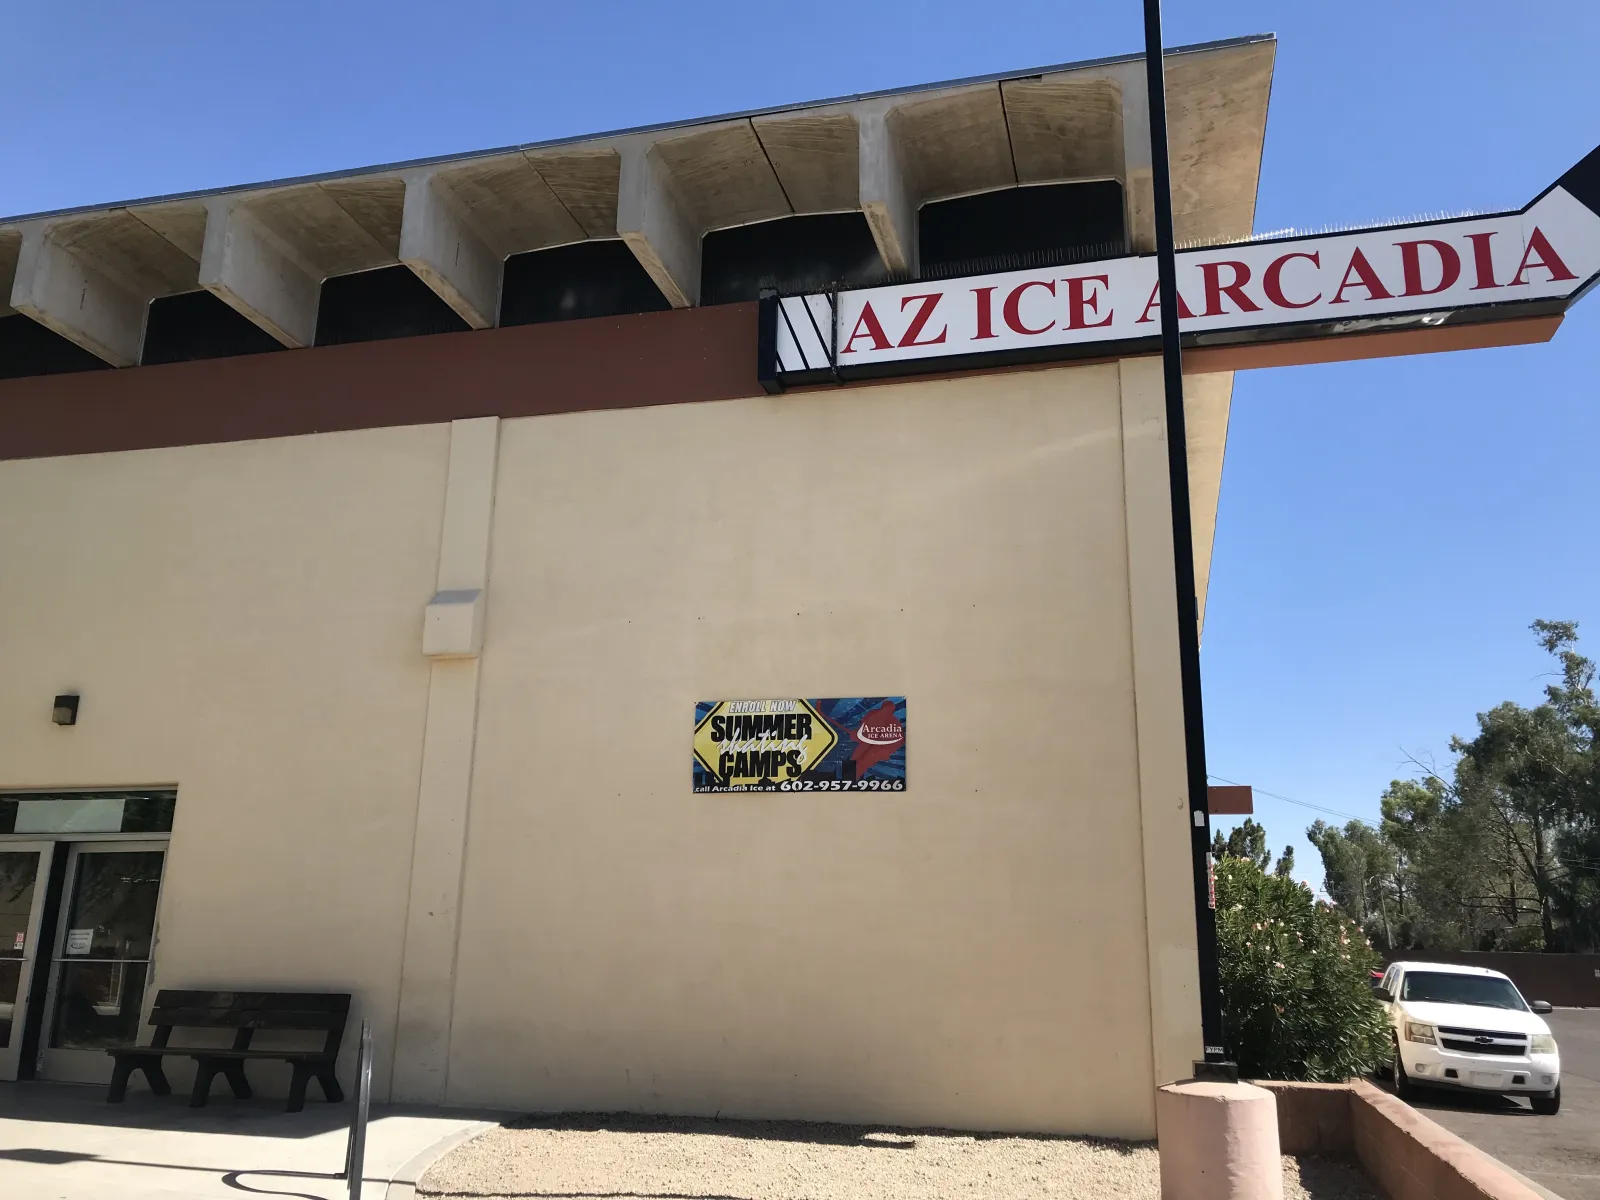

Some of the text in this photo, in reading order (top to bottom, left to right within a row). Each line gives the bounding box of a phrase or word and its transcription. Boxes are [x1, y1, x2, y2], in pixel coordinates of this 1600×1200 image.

[840, 226, 1579, 354] AZ ICE ARCADIA
[729, 699, 796, 713] ENROLL NOW
[711, 714, 811, 742] SUMMER
[863, 723, 902, 733] Arcadia
[719, 750, 802, 778] CAMPS
[780, 780, 903, 791] 602-957-9966
